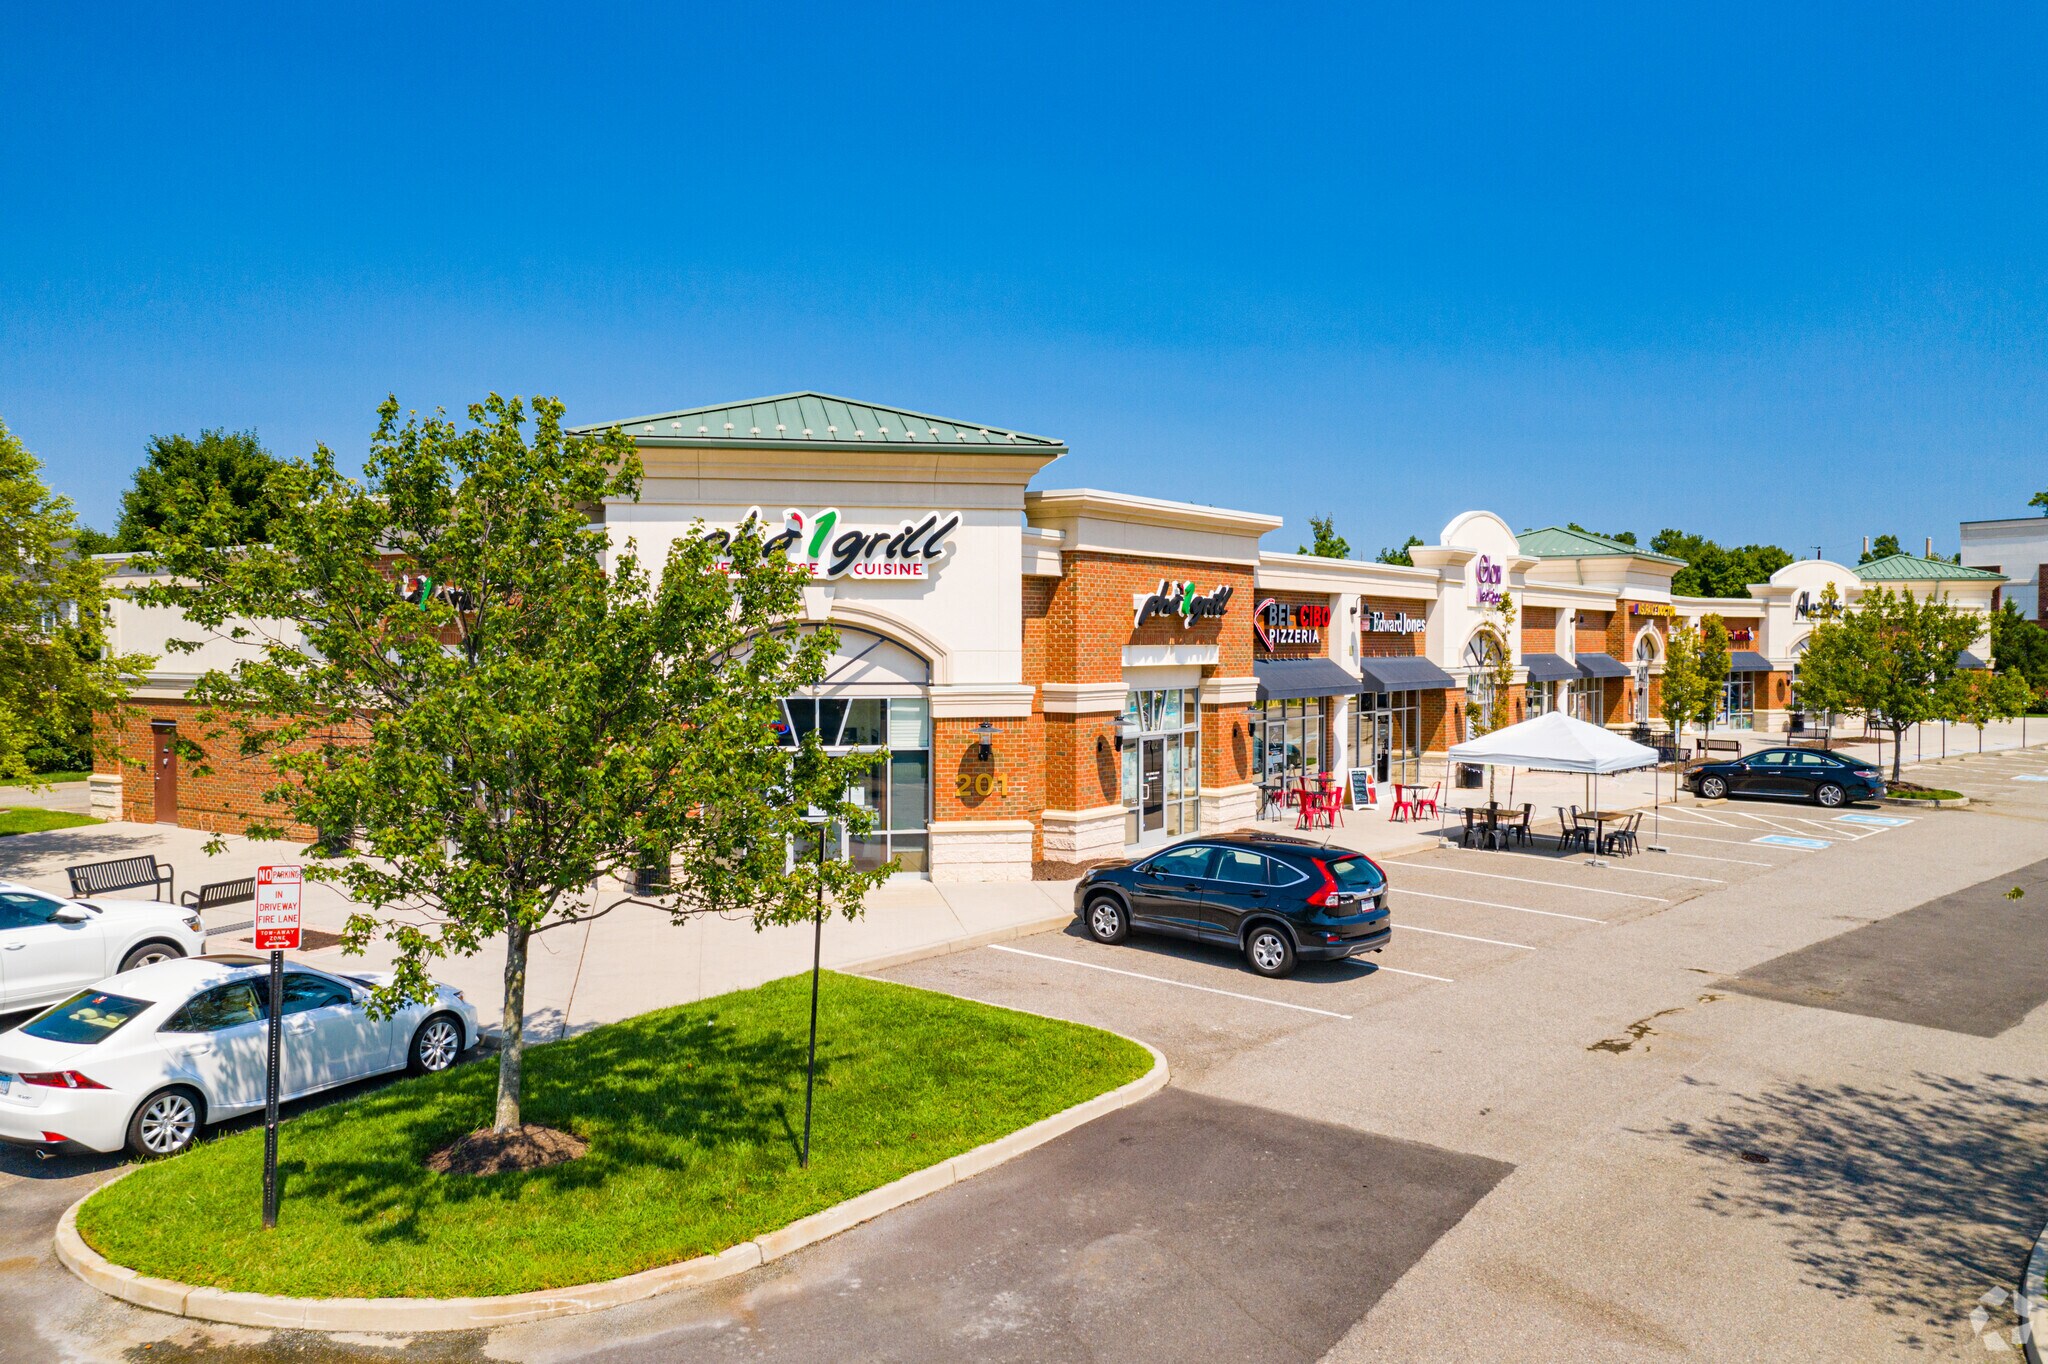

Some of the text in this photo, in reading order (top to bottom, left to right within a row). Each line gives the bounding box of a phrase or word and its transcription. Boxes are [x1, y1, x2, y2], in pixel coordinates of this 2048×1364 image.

[828, 515, 959, 576] grill
[854, 563, 923, 575] CUISINE
[1269, 604, 1331, 627] BEL CIBO
[1269, 629, 1319, 643] PIZZERIA
[955, 773, 1008, 797] 201
[259, 869, 299, 881] NO PARKING
[260, 903, 297, 911] DRIVEWAY
